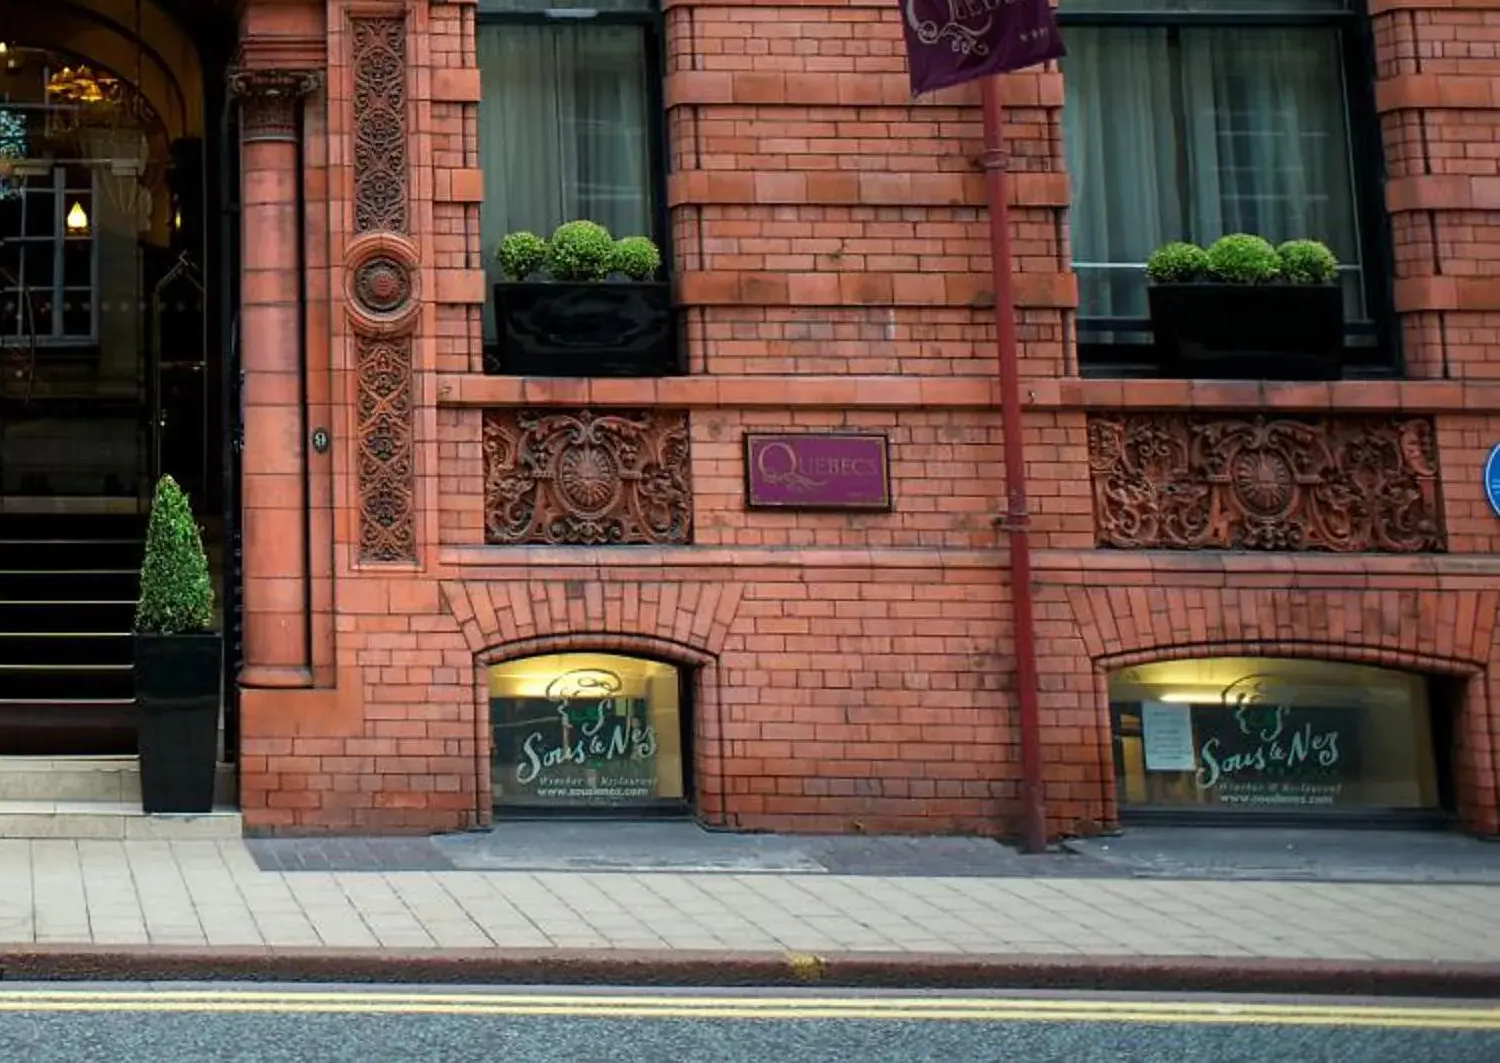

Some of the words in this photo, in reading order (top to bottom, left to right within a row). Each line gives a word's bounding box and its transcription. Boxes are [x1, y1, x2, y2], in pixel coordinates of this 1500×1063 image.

[516, 732, 585, 784] Sous
[606, 713, 657, 759] Nez
[1196, 738, 1265, 787] Sous
[1287, 724, 1340, 767] Nez
